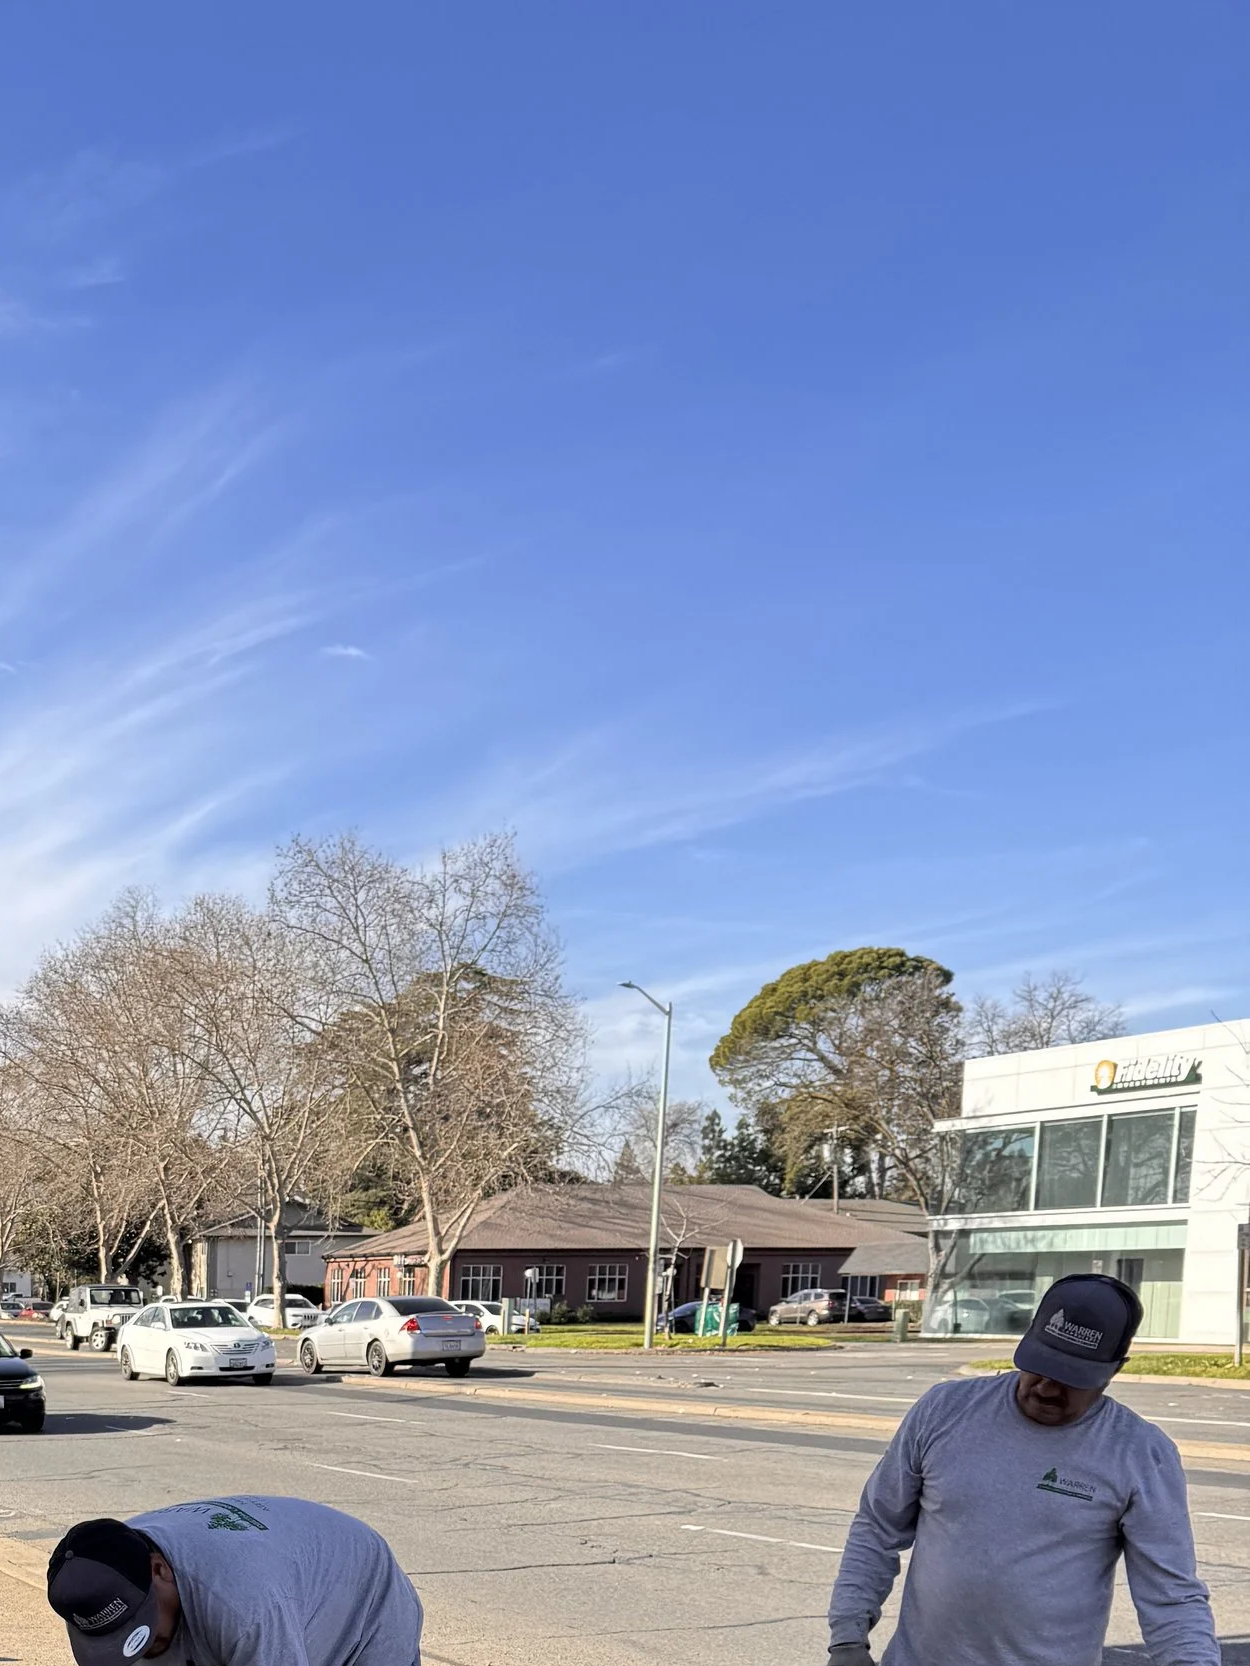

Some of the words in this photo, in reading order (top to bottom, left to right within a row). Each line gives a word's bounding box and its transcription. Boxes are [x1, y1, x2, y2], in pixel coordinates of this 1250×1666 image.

[1115, 1055, 1197, 1083] Fidelity
[1064, 1320, 1103, 1341] WARREN
[1059, 1478, 1097, 1494] WARREN
